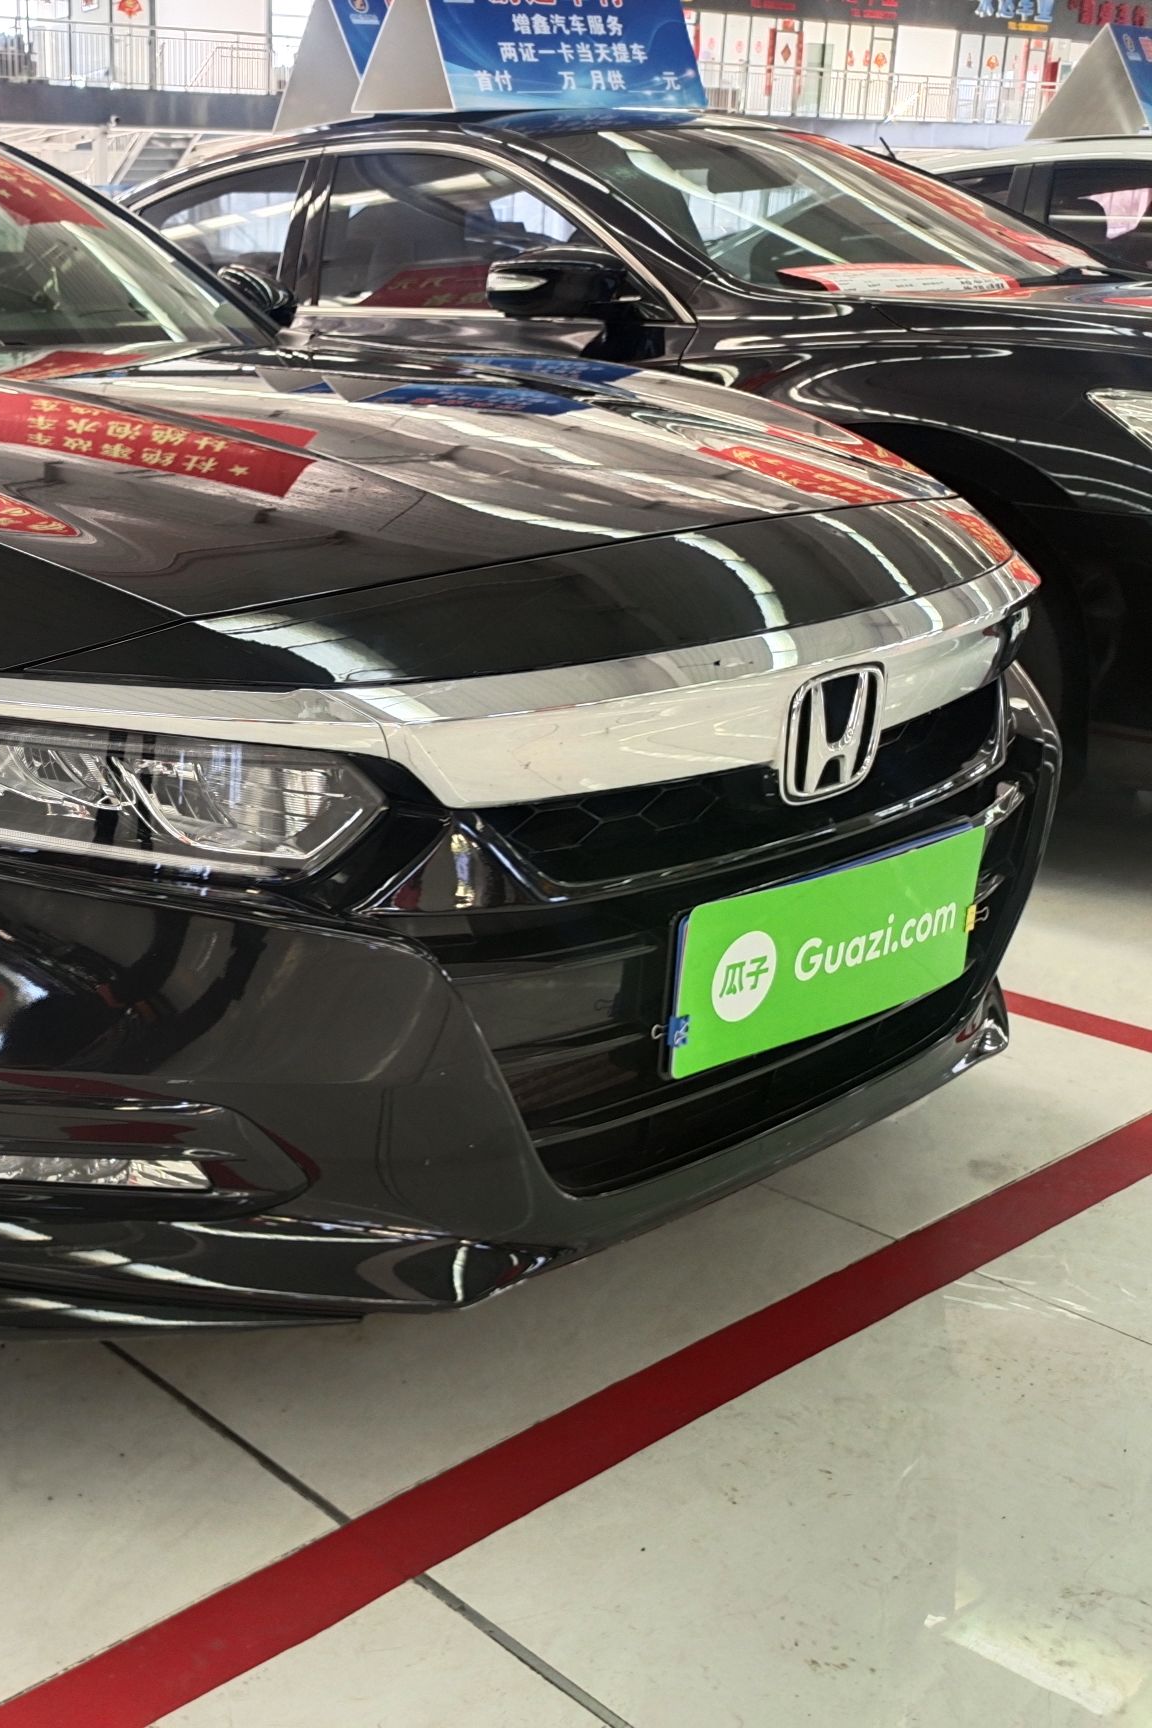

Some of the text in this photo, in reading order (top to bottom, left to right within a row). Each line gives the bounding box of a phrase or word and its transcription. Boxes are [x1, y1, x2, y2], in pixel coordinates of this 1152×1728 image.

[512, 13, 623, 36] 增鑫汽车服务
[498, 42, 648, 64] 两证一卡当天提车
[475, 70, 681, 92] 首付 万 月供 元
[718, 901, 957, 999] 瓜子 Guazi.com
